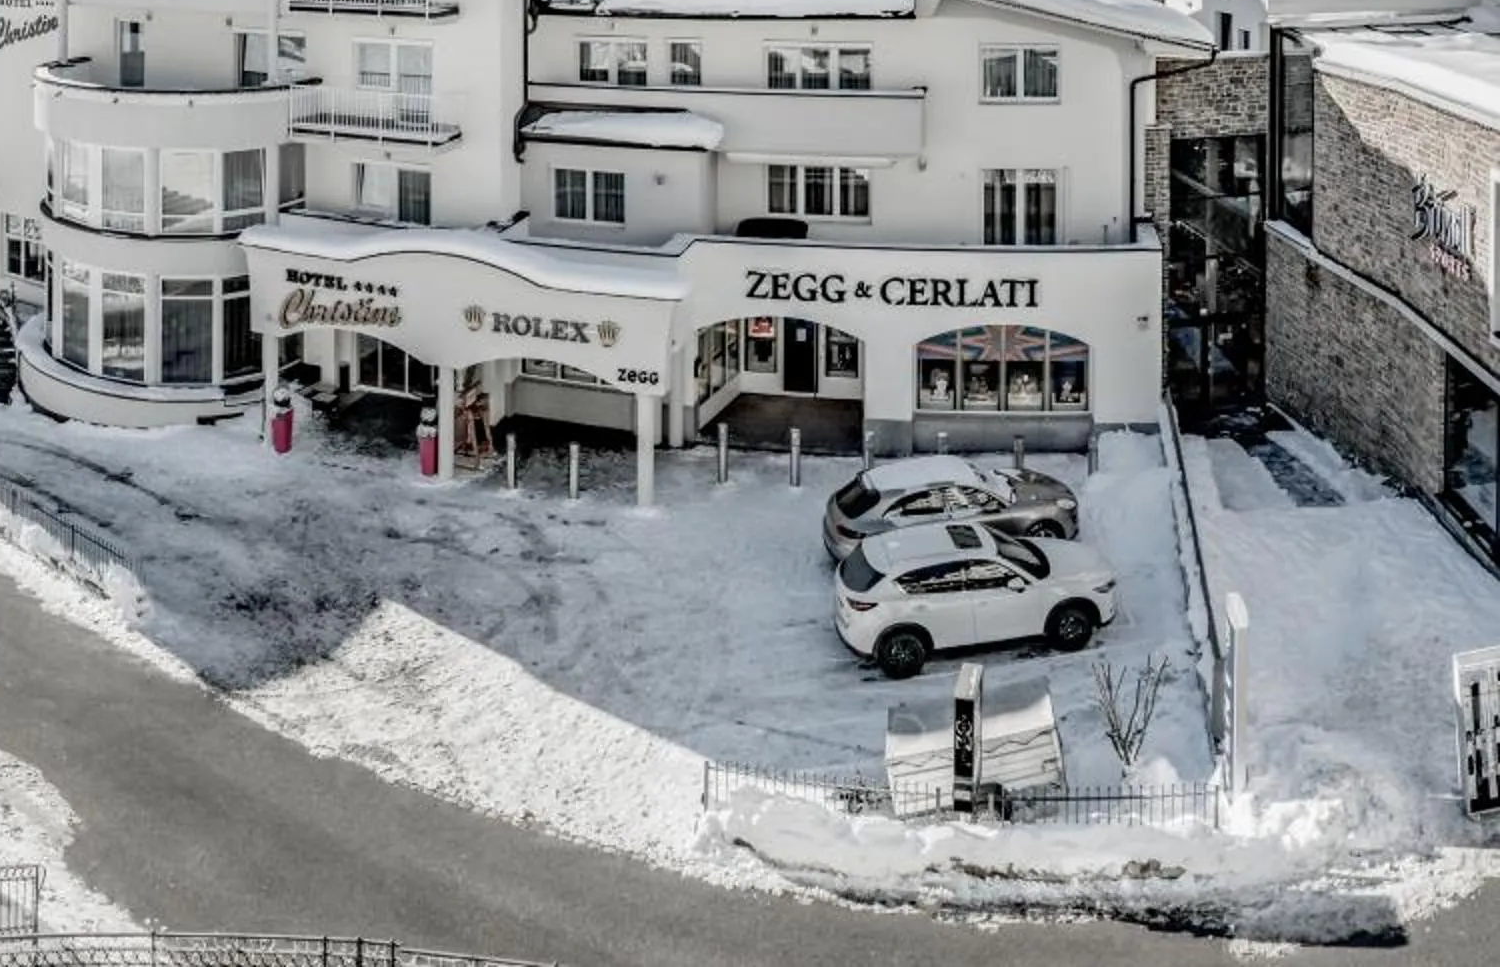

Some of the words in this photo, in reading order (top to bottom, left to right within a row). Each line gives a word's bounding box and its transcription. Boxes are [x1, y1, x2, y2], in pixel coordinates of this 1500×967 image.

[286, 269, 347, 291] HOTEL
[746, 271, 846, 302] ZEGG
[853, 281, 873, 298] &
[879, 277, 1040, 308] CERLATI
[280, 288, 402, 329] Christine
[492, 313, 591, 344] ROLEX
